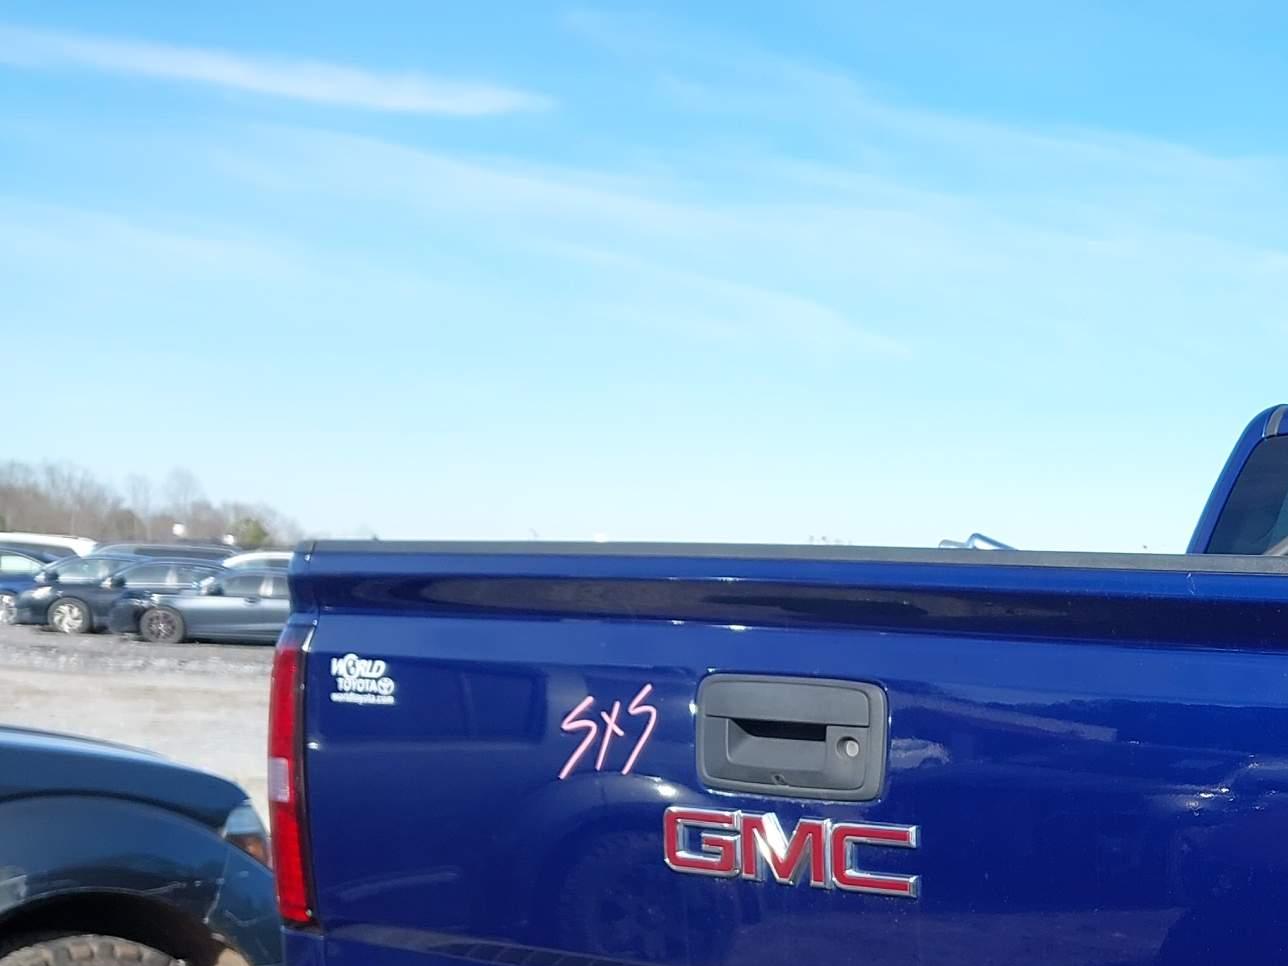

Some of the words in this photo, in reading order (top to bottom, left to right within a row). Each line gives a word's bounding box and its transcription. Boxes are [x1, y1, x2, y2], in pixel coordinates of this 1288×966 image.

[329, 652, 387, 679] WORLD
[336, 676, 378, 693] TOYOTA
[663, 805, 919, 899] GMC
